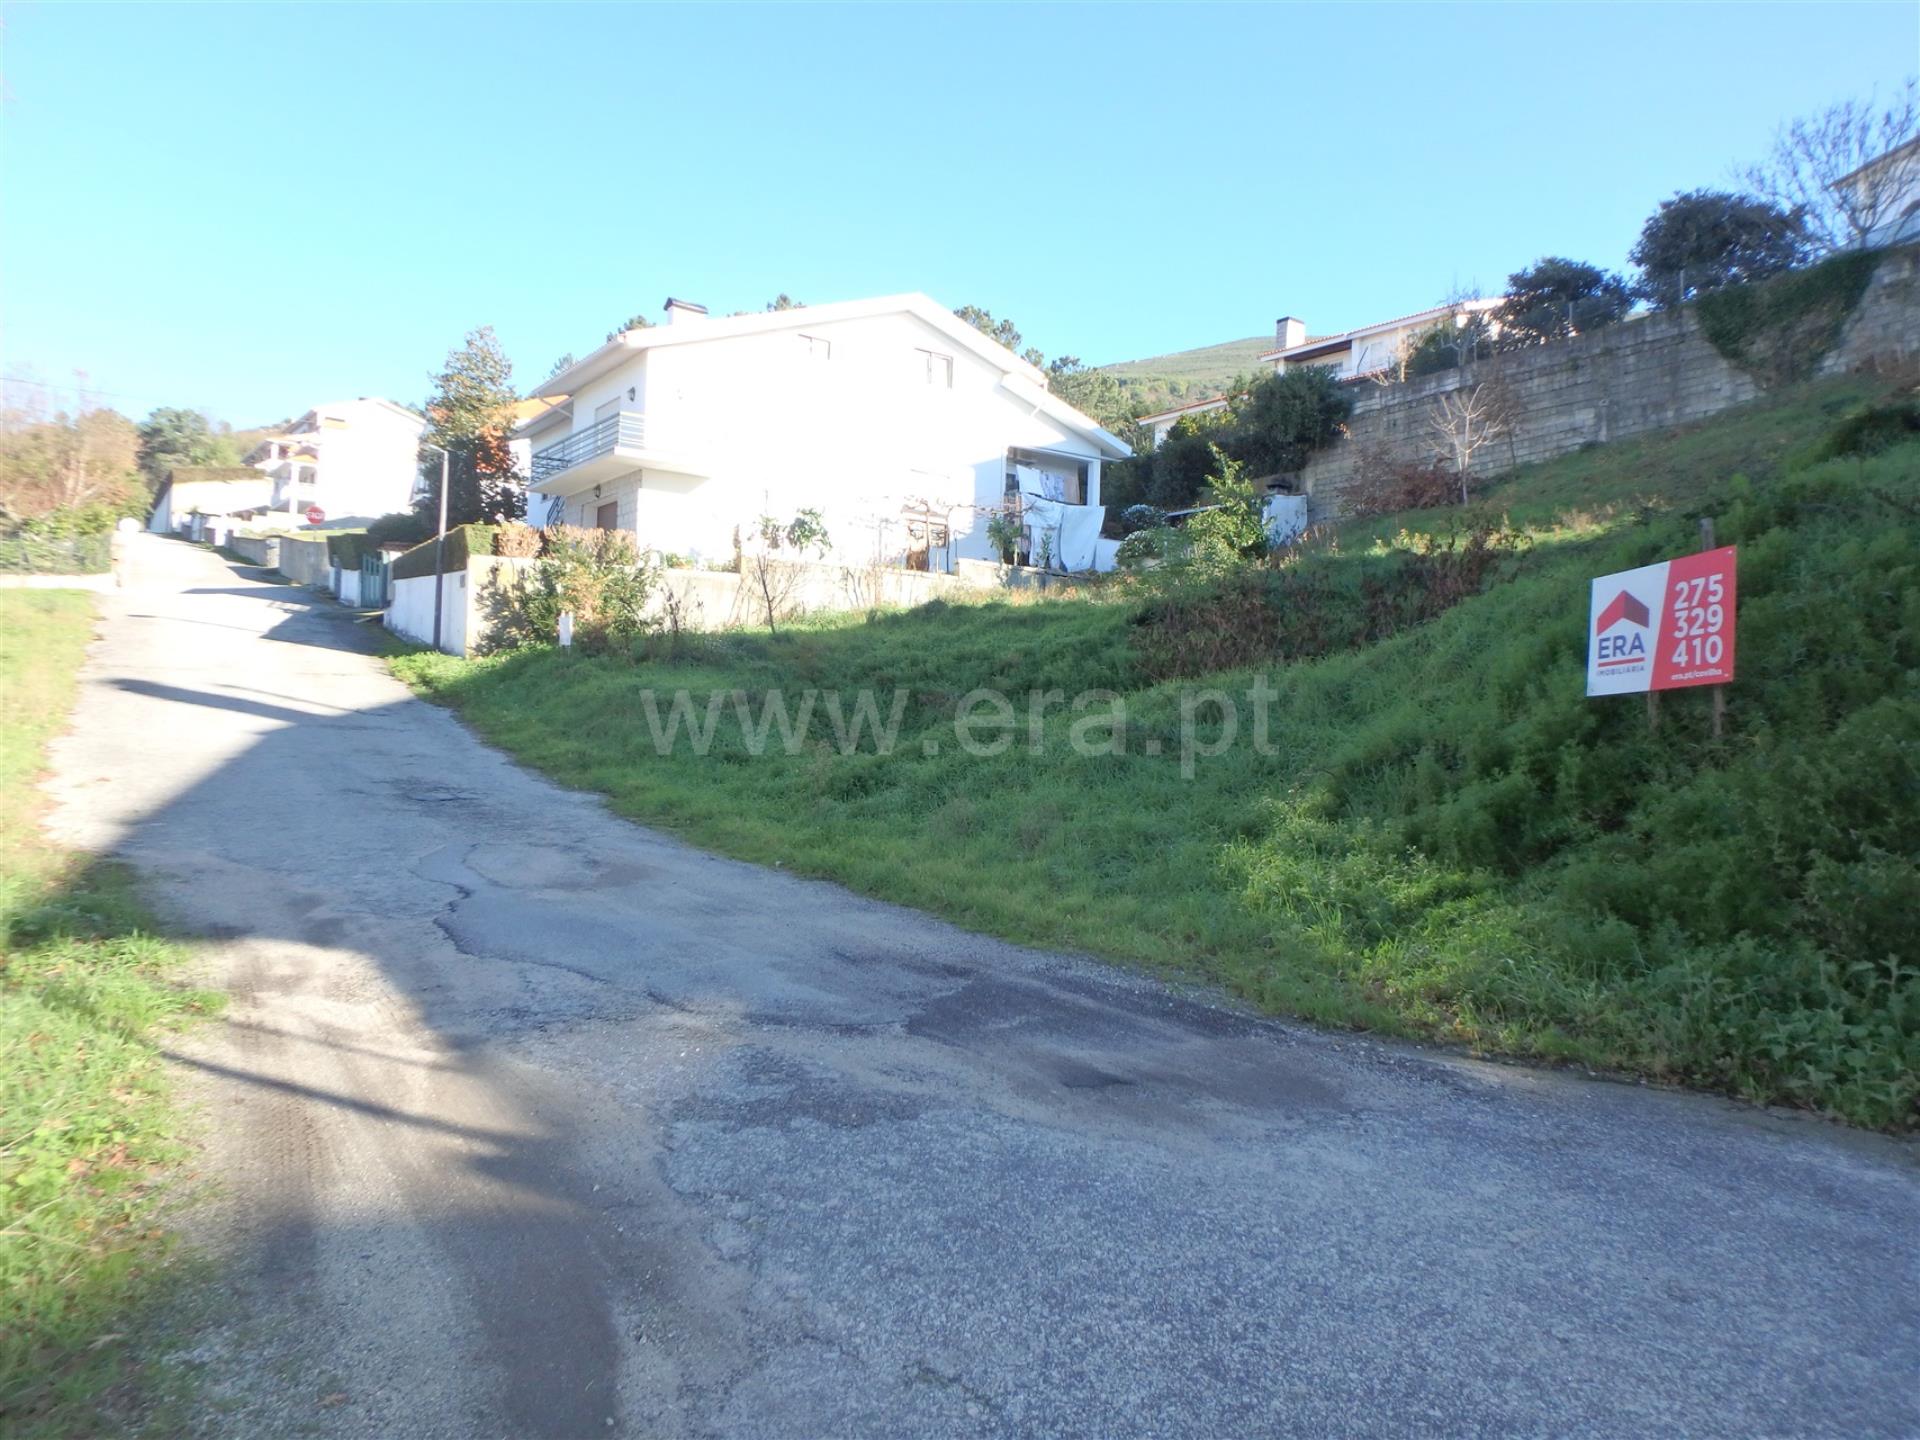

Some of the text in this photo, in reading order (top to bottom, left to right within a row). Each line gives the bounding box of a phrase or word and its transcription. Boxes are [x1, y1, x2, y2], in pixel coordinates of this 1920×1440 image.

[1674, 574, 1723, 610] 275
[1674, 604, 1723, 638] 329
[1598, 632, 1645, 659] ERA
[1672, 635, 1723, 667] 410
